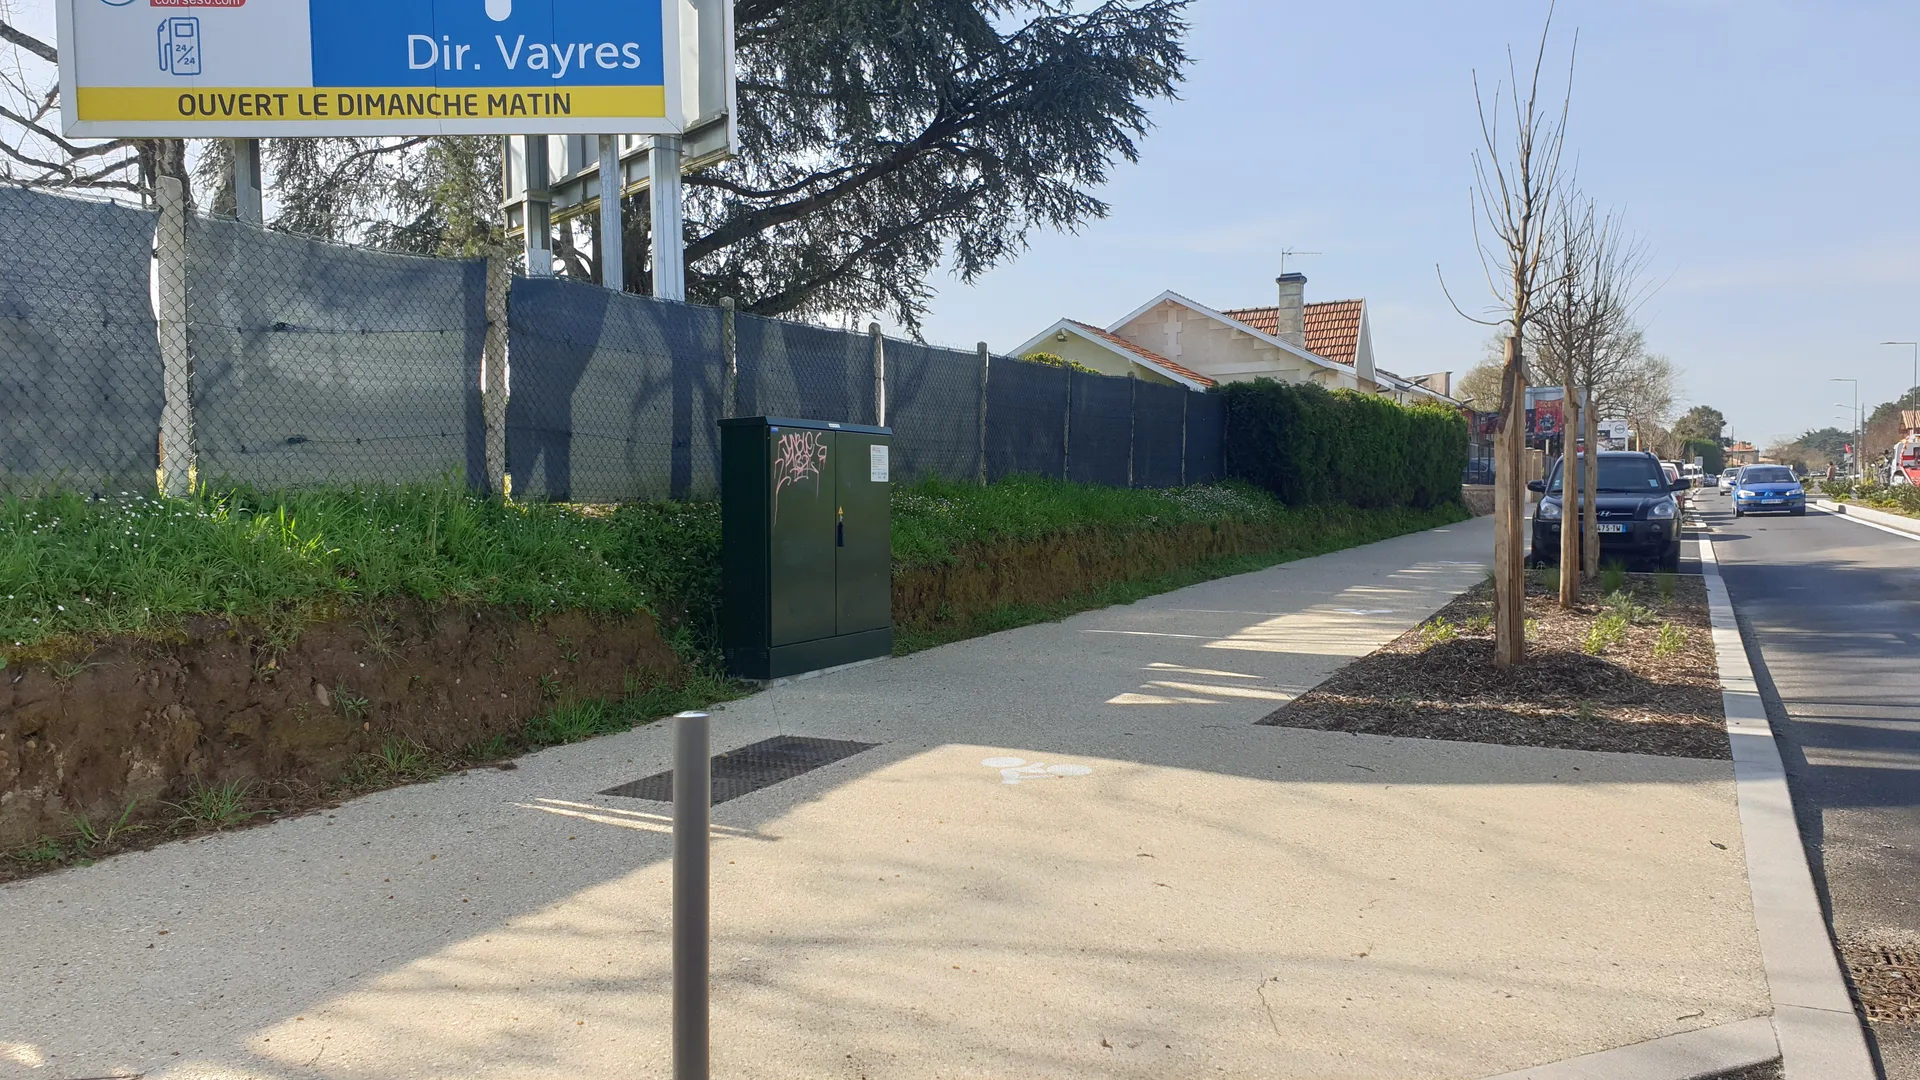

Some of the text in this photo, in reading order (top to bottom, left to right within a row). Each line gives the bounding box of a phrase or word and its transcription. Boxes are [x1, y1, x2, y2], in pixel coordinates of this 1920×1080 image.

[407, 34, 641, 79] Dir. Vayres
[178, 93, 571, 116] OUVERT LE DIMANCHE MATIN
